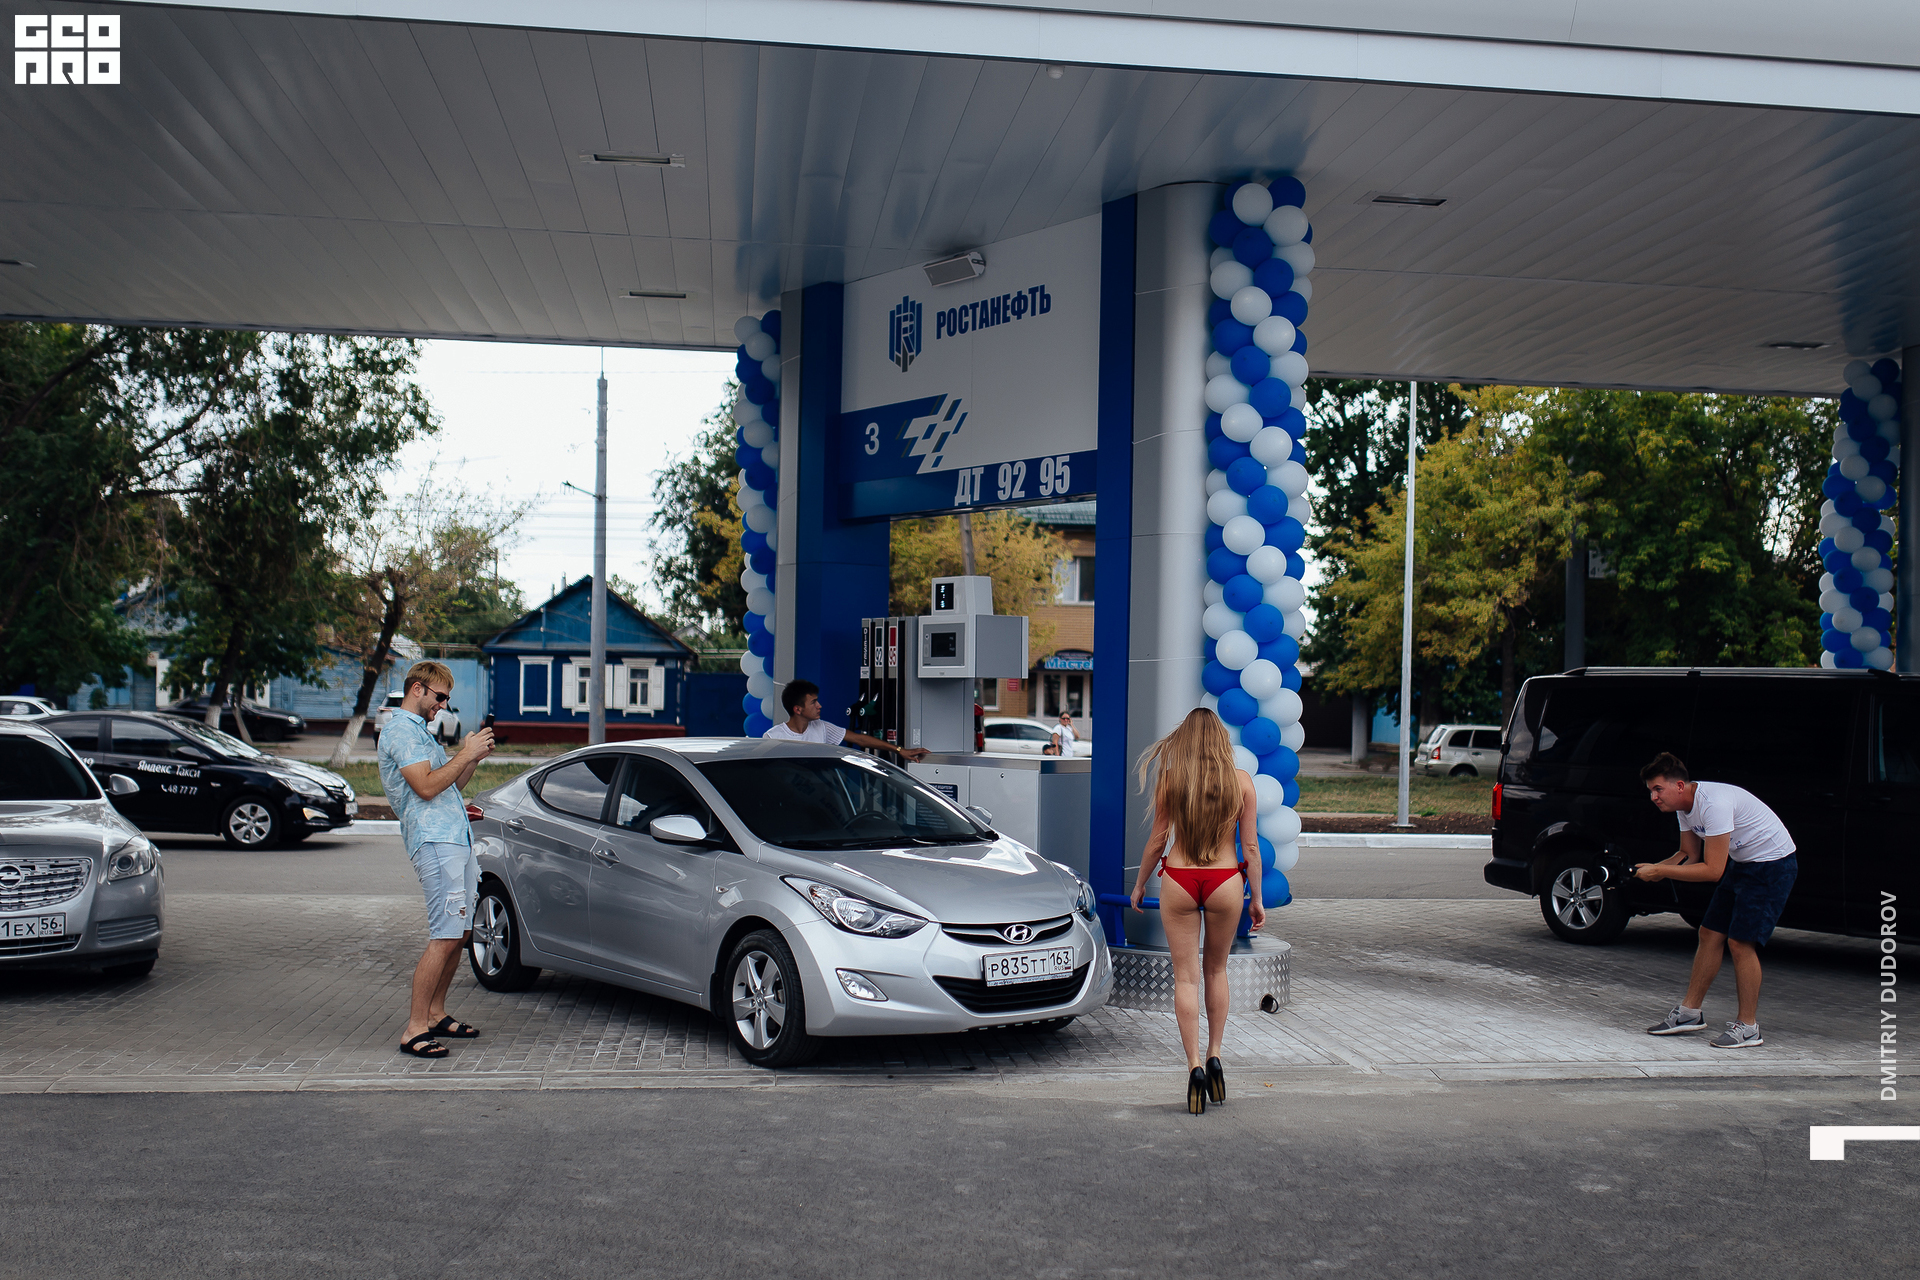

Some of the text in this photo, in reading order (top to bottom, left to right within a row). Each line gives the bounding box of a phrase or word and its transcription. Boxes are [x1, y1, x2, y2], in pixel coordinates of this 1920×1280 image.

[936, 284, 1052, 340] РОСТАНЕФТЬ
[865, 422, 880, 455] 3
[954, 455, 1070, 506] ДТ 92 95
[1044, 656, 1094, 671] Масте
[138, 760, 200, 779] Яндекс Такси
[167, 784, 178, 794] 48
[41, 917, 58, 930] 56
[1049, 951, 1070, 966] 163
